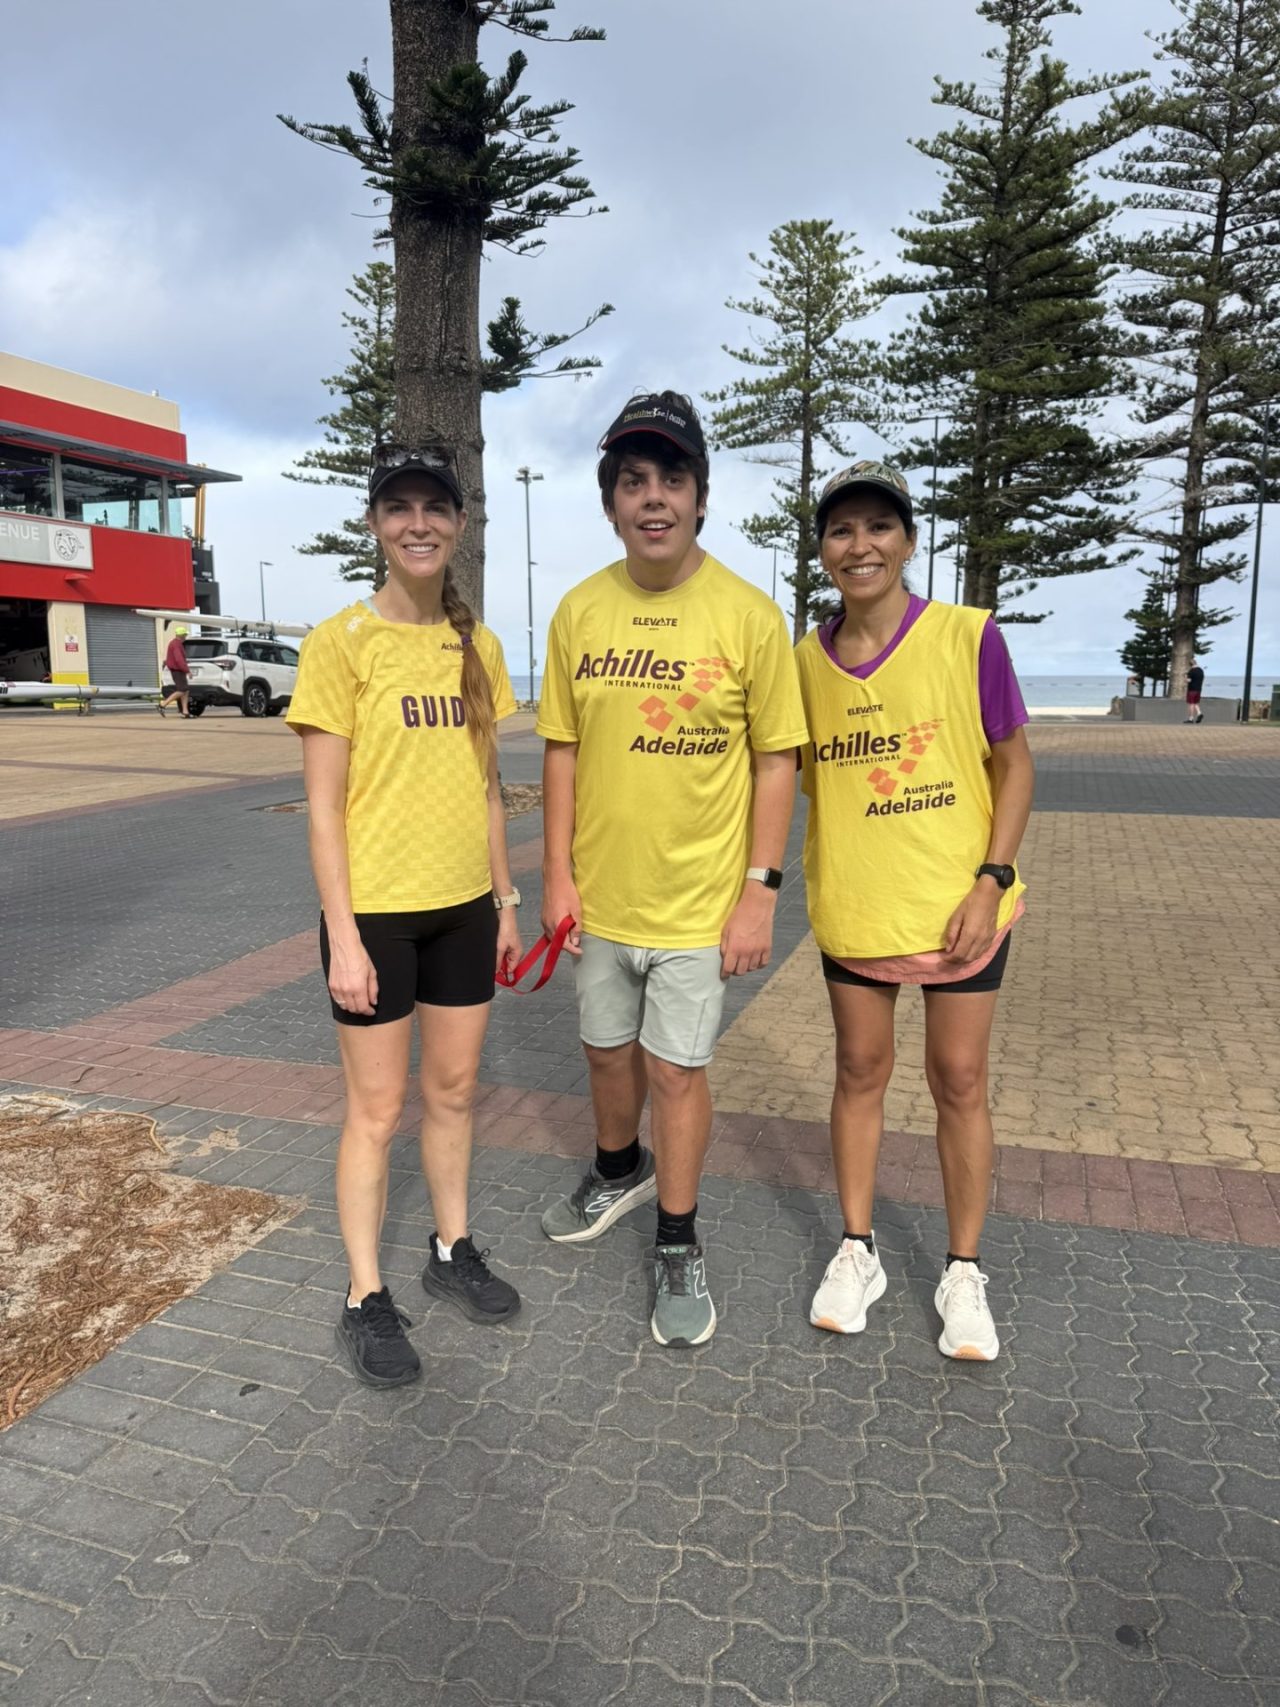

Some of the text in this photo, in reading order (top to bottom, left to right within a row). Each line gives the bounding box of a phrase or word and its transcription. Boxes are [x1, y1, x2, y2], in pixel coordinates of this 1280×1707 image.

[632, 617, 678, 627] ELEVATE
[575, 648, 687, 682] Achilles
[604, 680, 682, 692] INTERNATIONAL
[401, 695, 466, 728] GUID
[847, 704, 883, 716] ELEVATE
[677, 726, 730, 736] Australia
[629, 735, 728, 756] Adelaide
[836, 754, 901, 768] INTERNATIONAL
[903, 780, 954, 795] Australia
[865, 793, 956, 817] Adelaide
